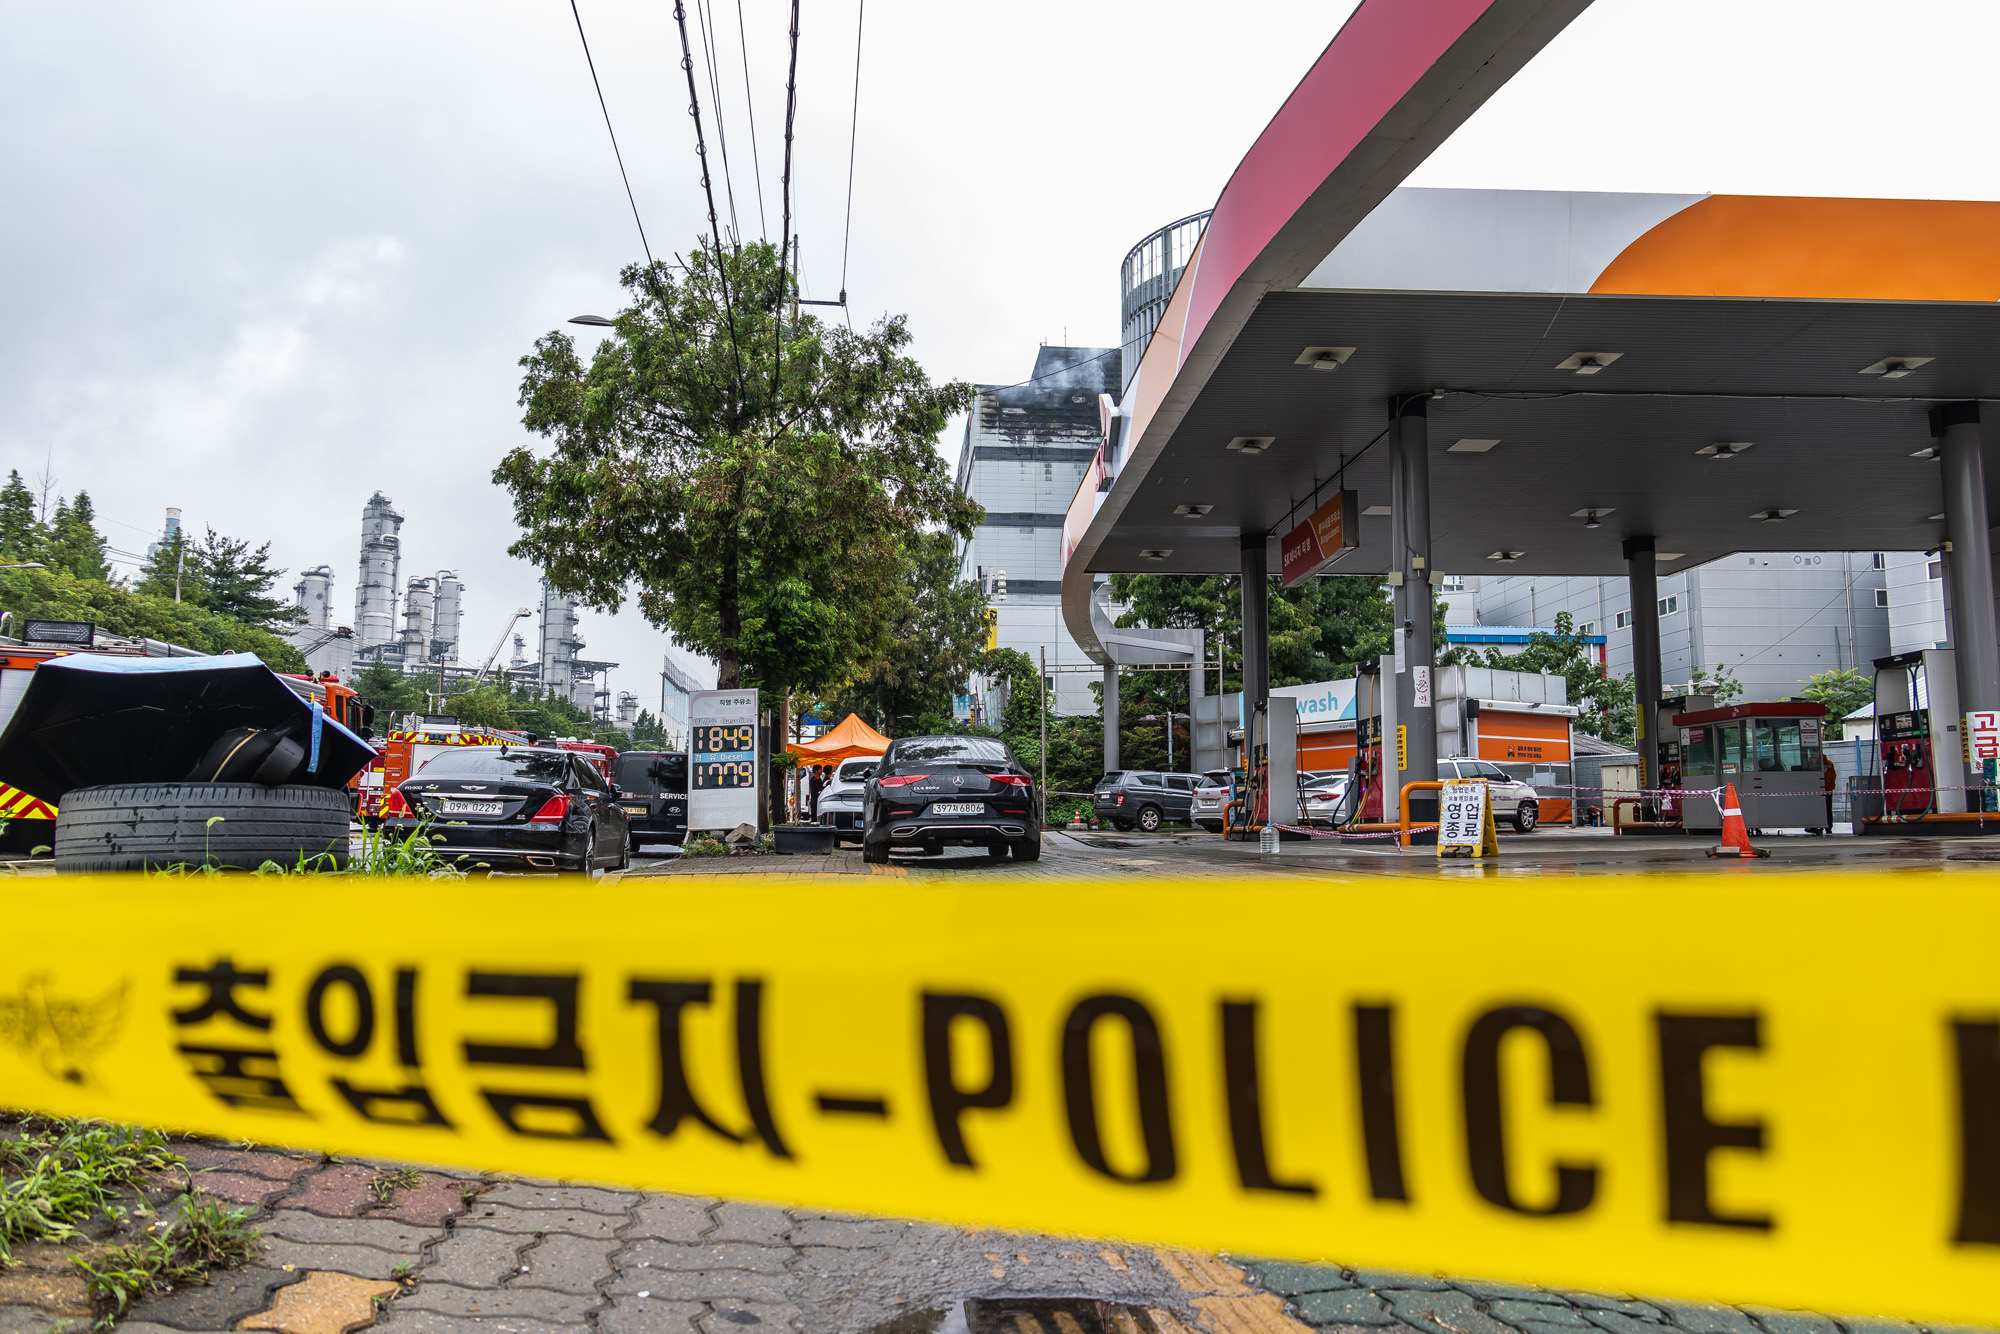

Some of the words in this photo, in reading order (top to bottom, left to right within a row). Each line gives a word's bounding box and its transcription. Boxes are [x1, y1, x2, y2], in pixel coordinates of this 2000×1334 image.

[1297, 691, 1338, 714] wash
[720, 716, 753, 725] Gasoline
[698, 726, 753, 752] 1849
[1973, 713, 1999, 759] 고급
[698, 761, 752, 787] 1779
[659, 792, 688, 800] SERVICE
[449, 802, 468, 812] 09어
[472, 803, 497, 812] 0229
[1447, 803, 1480, 820] 영업
[1445, 822, 1478, 838] 종료
